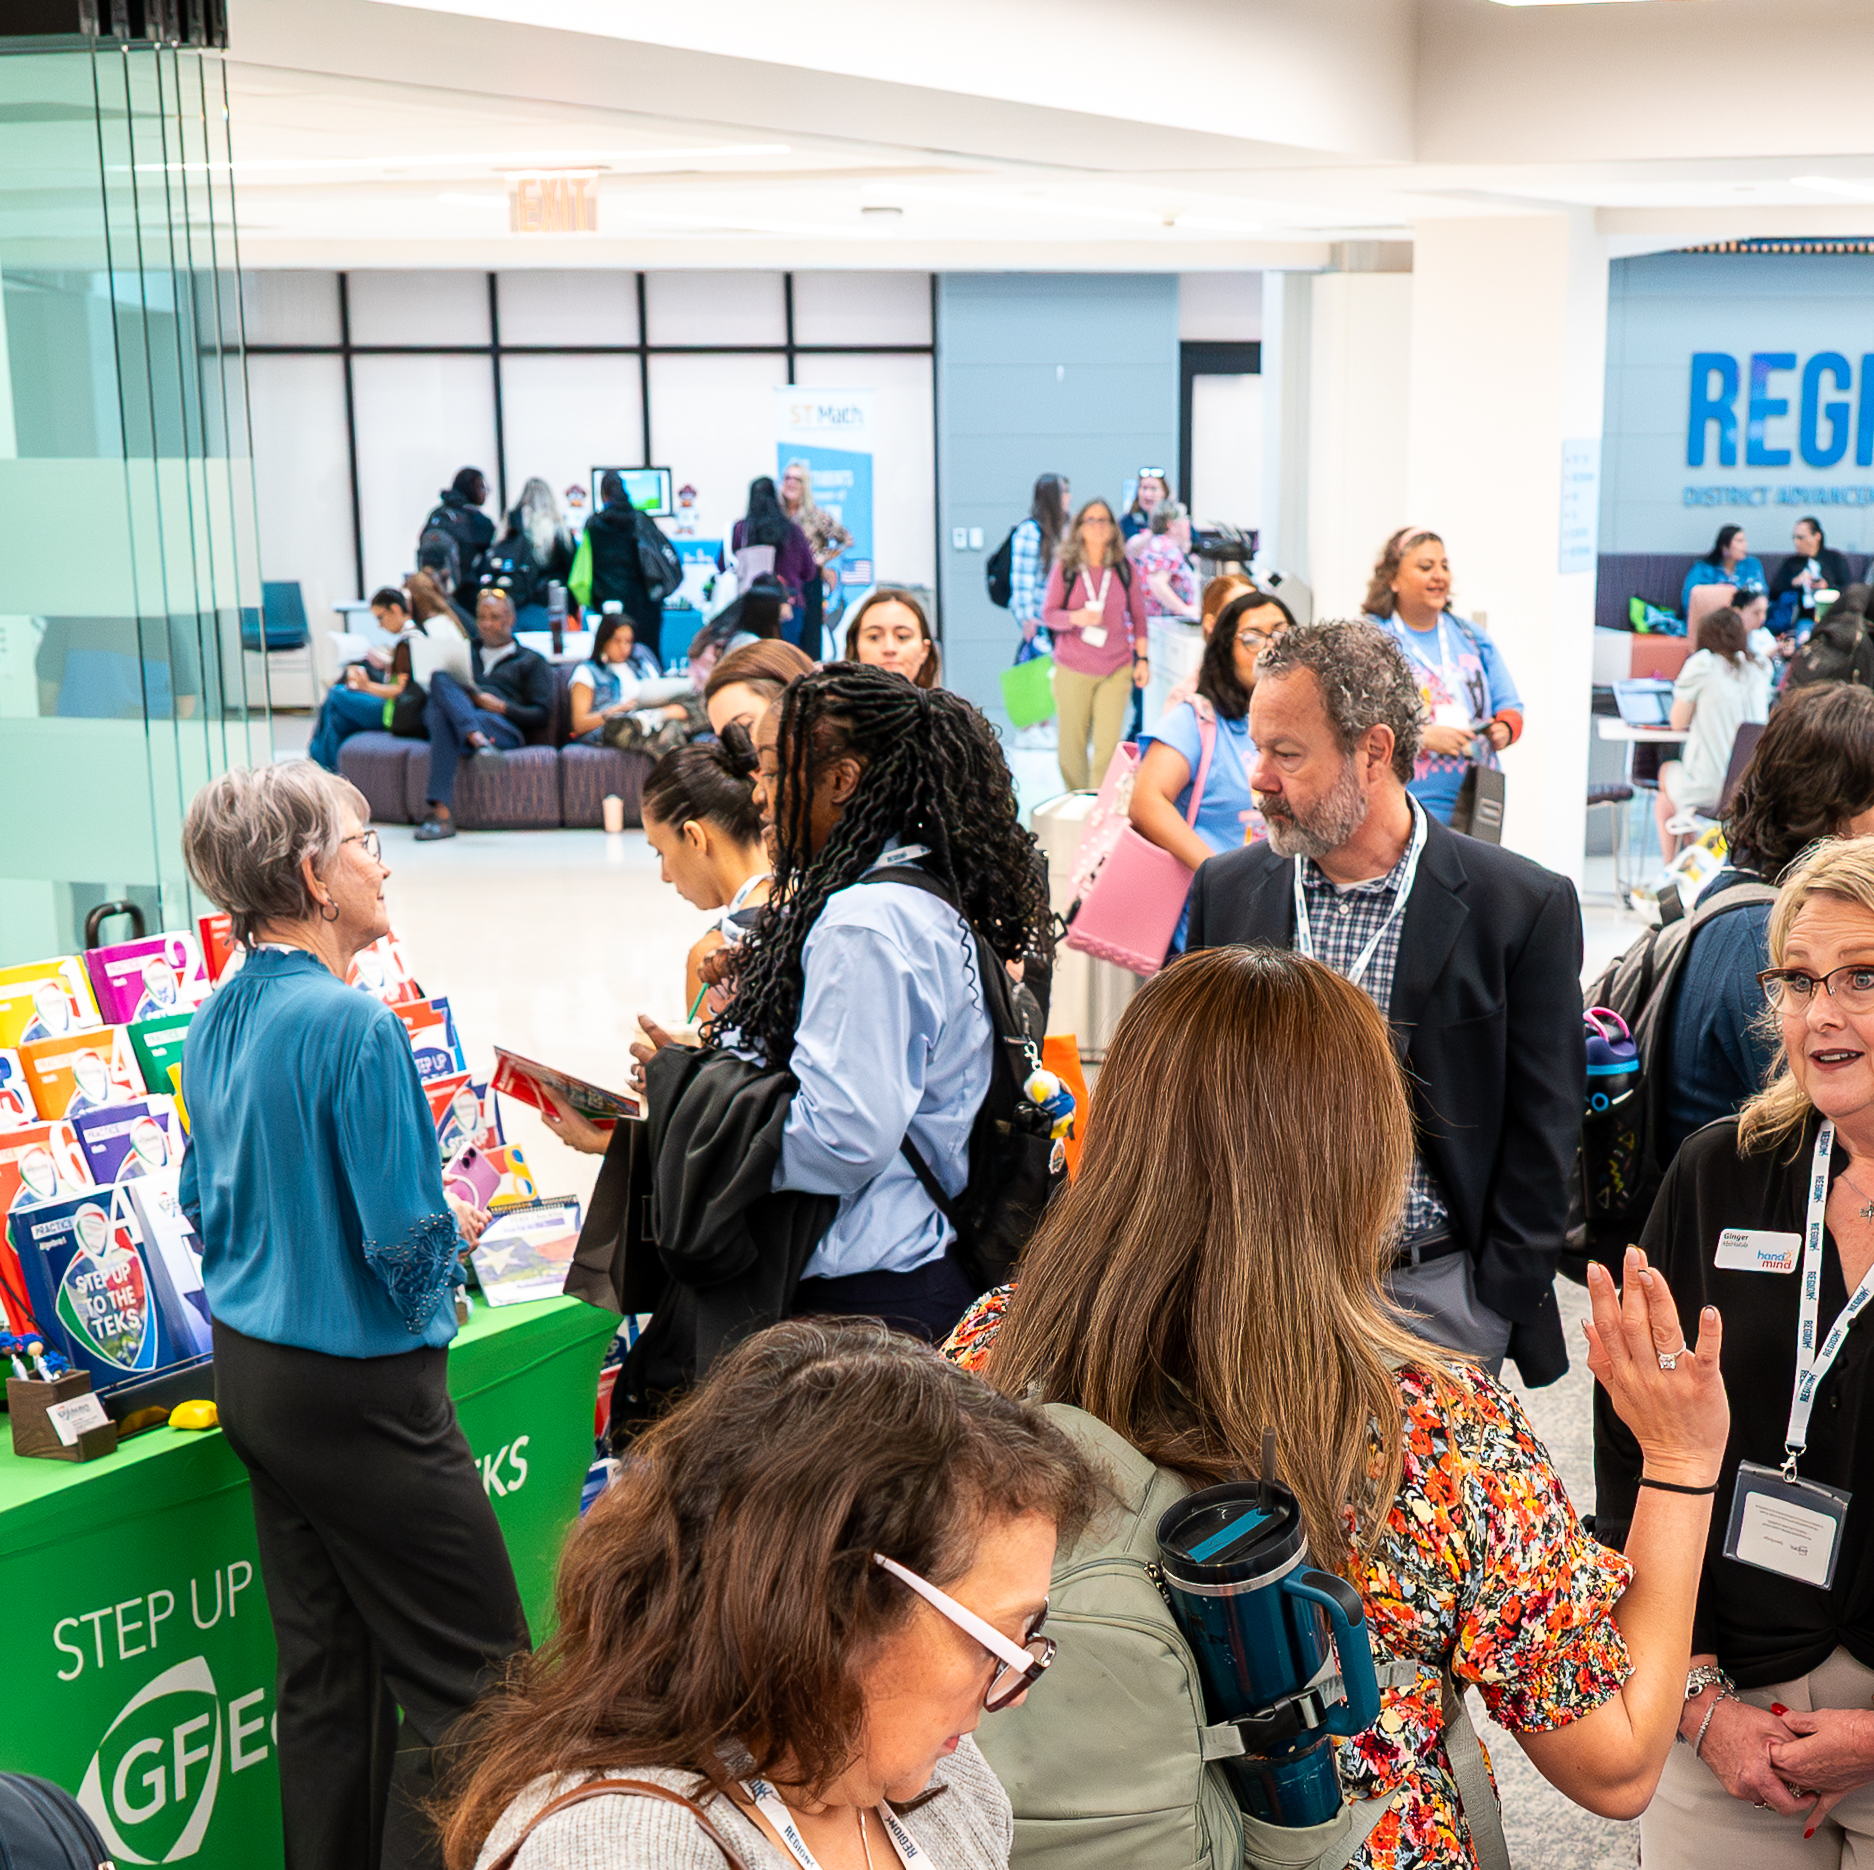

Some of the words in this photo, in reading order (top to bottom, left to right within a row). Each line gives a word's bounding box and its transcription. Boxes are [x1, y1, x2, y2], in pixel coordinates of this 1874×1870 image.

[518, 178, 590, 232] EXIT
[817, 404, 865, 424] Math
[1683, 485, 1769, 507] DISTRICT
[164, 932, 214, 998] 2
[33, 1215, 73, 1236] PRACTICE
[1723, 1232, 1749, 1242] Ginger
[75, 1267, 109, 1294] STEP
[111, 1261, 132, 1285] UP
[1761, 1259, 1792, 1270] mind
[85, 1294, 108, 1314] TO
[108, 1285, 137, 1309] THE
[91, 1308, 141, 1341] TEKS
[52, 1588, 176, 1682] STEP
[190, 1560, 254, 1631] UP
